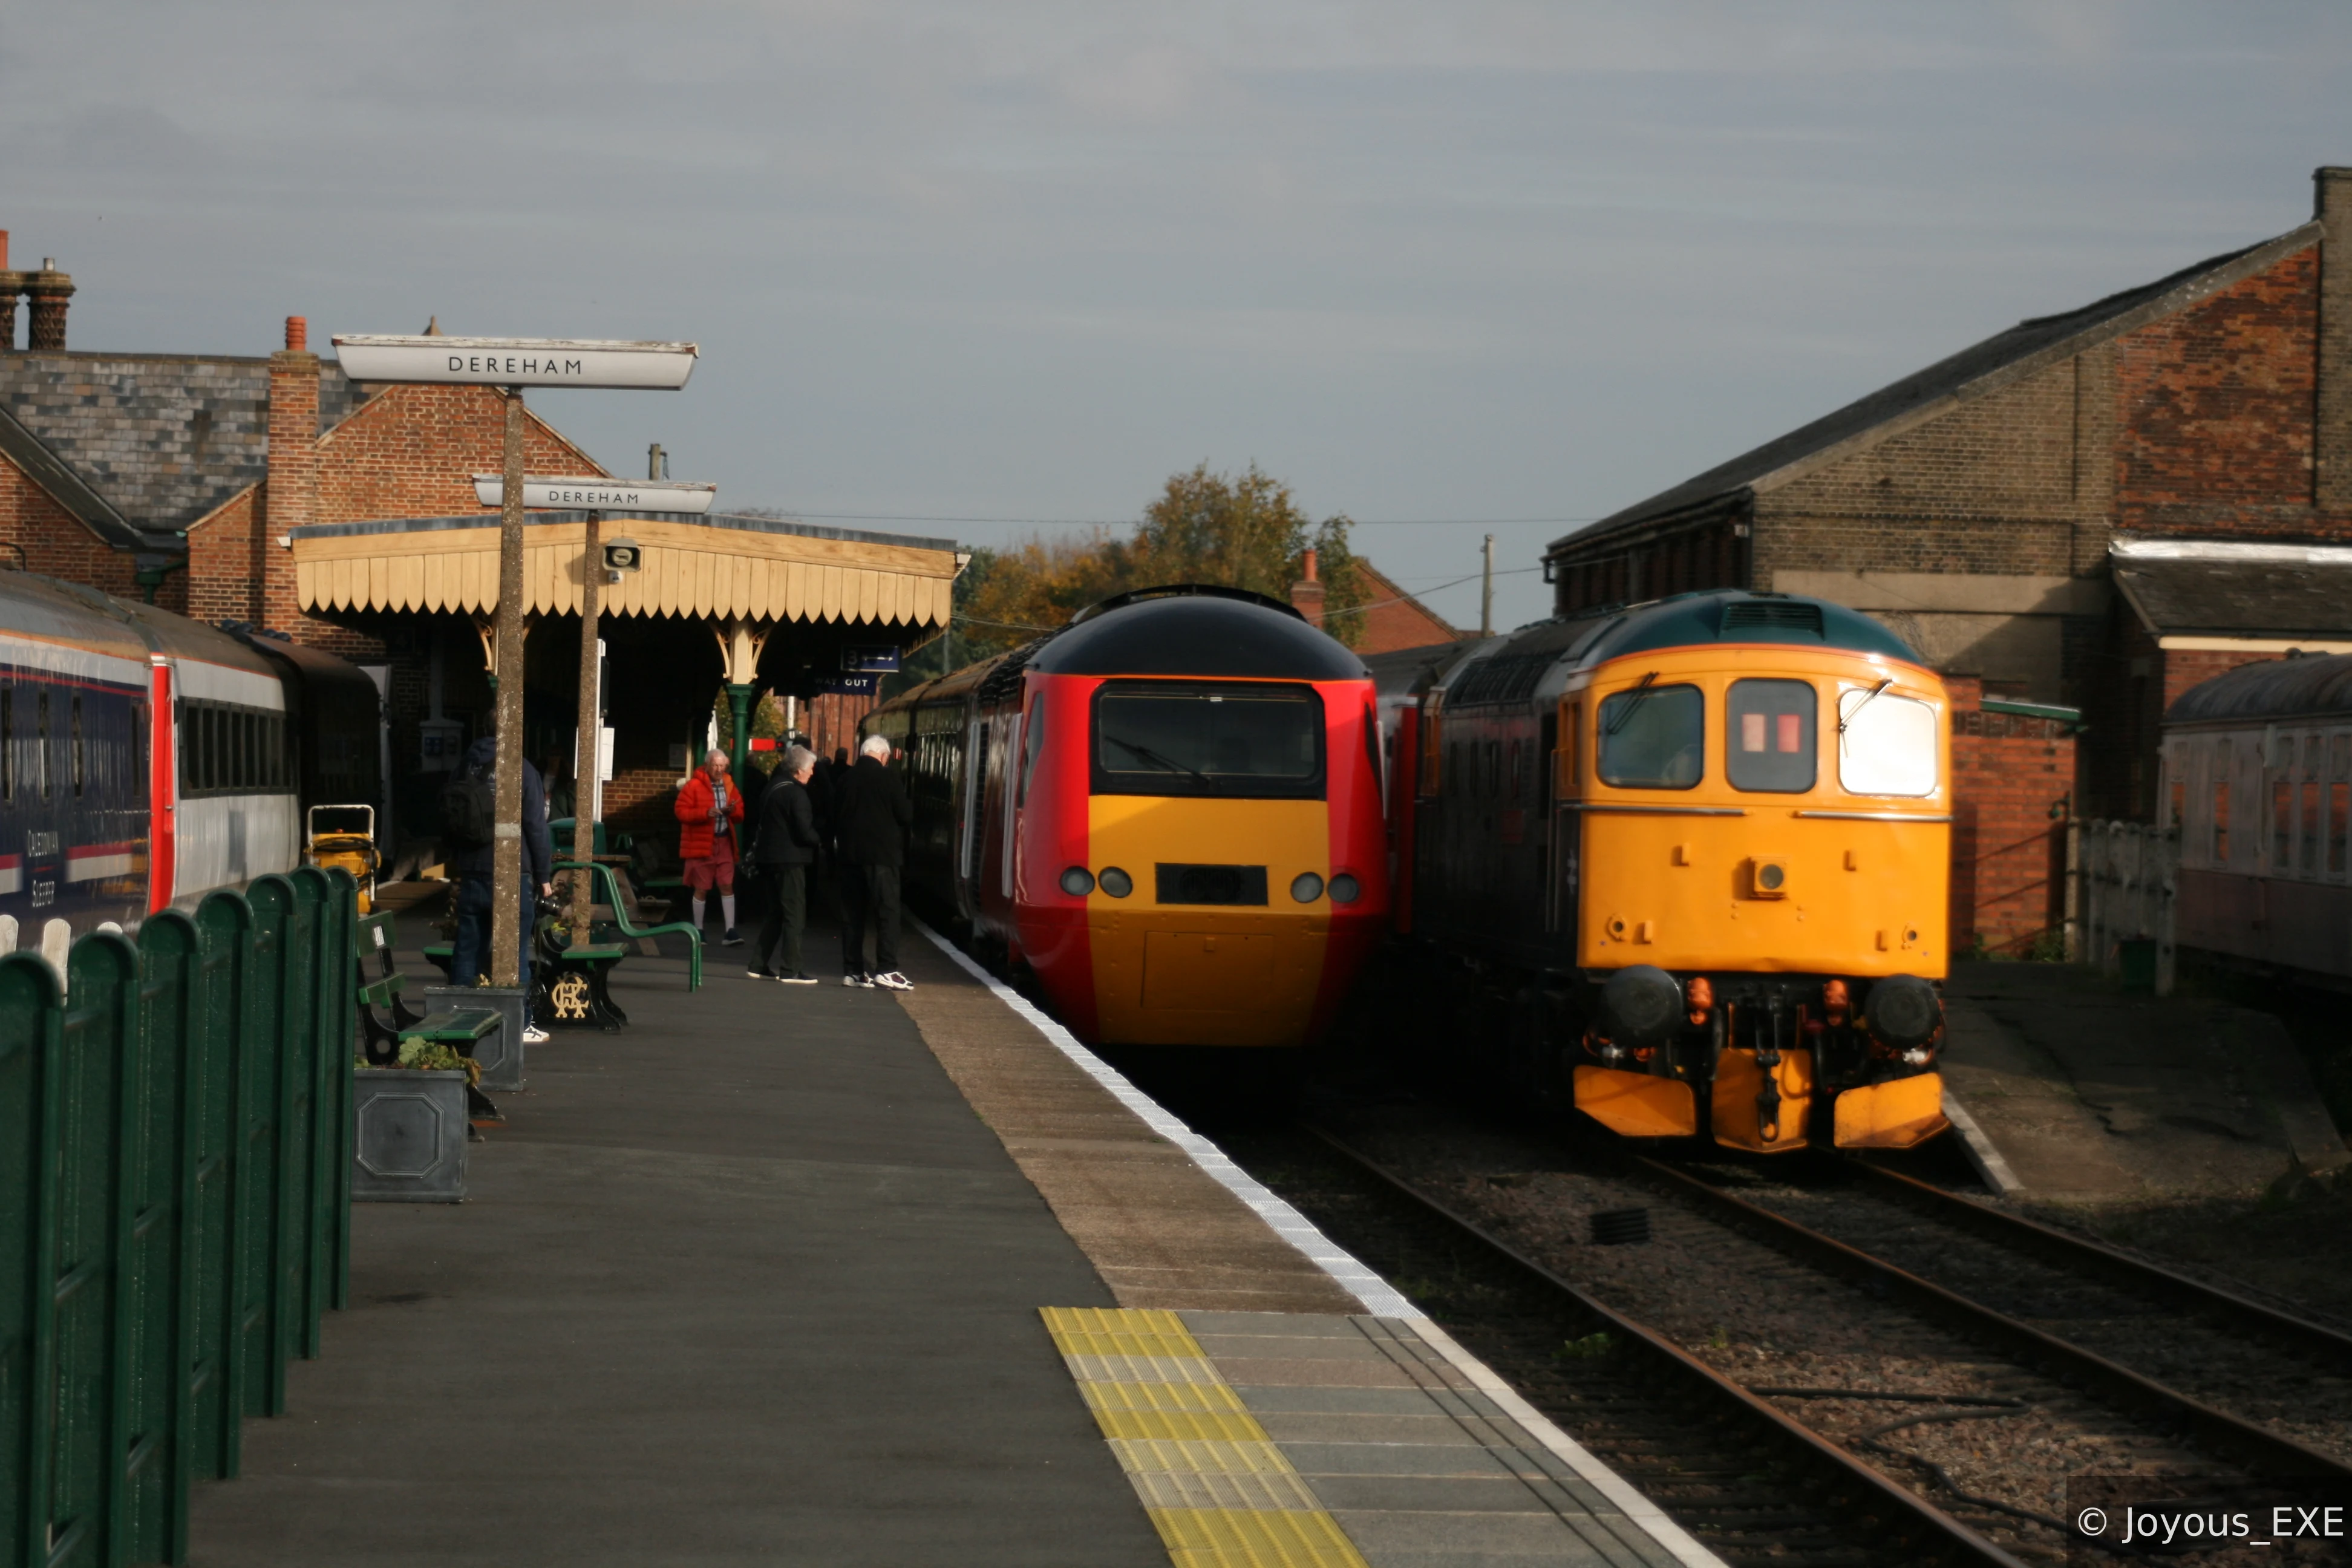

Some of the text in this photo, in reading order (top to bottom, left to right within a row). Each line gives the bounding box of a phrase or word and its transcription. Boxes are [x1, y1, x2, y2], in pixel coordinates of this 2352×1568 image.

[448, 356, 583, 375] DEREHAM
[548, 491, 639, 505] DEREHAM
[814, 677, 869, 687] WAY OUT
